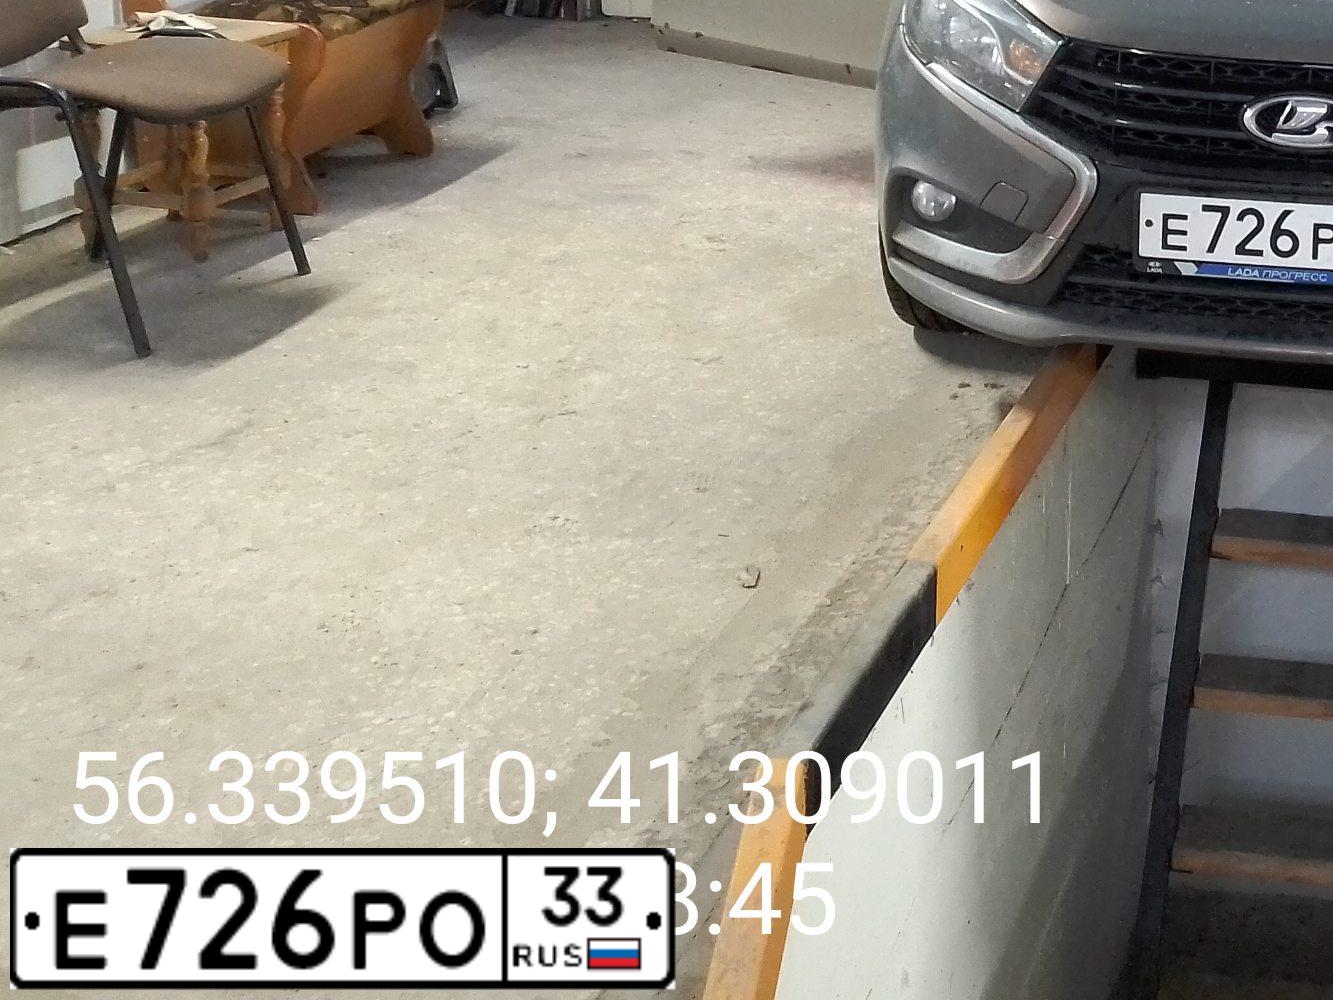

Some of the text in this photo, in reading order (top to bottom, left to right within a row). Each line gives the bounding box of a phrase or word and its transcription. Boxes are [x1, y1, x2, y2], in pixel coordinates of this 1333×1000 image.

[1146, 266, 1163, 274] LADA
[1227, 267, 1328, 282] LADA ПРОГРЕСС
